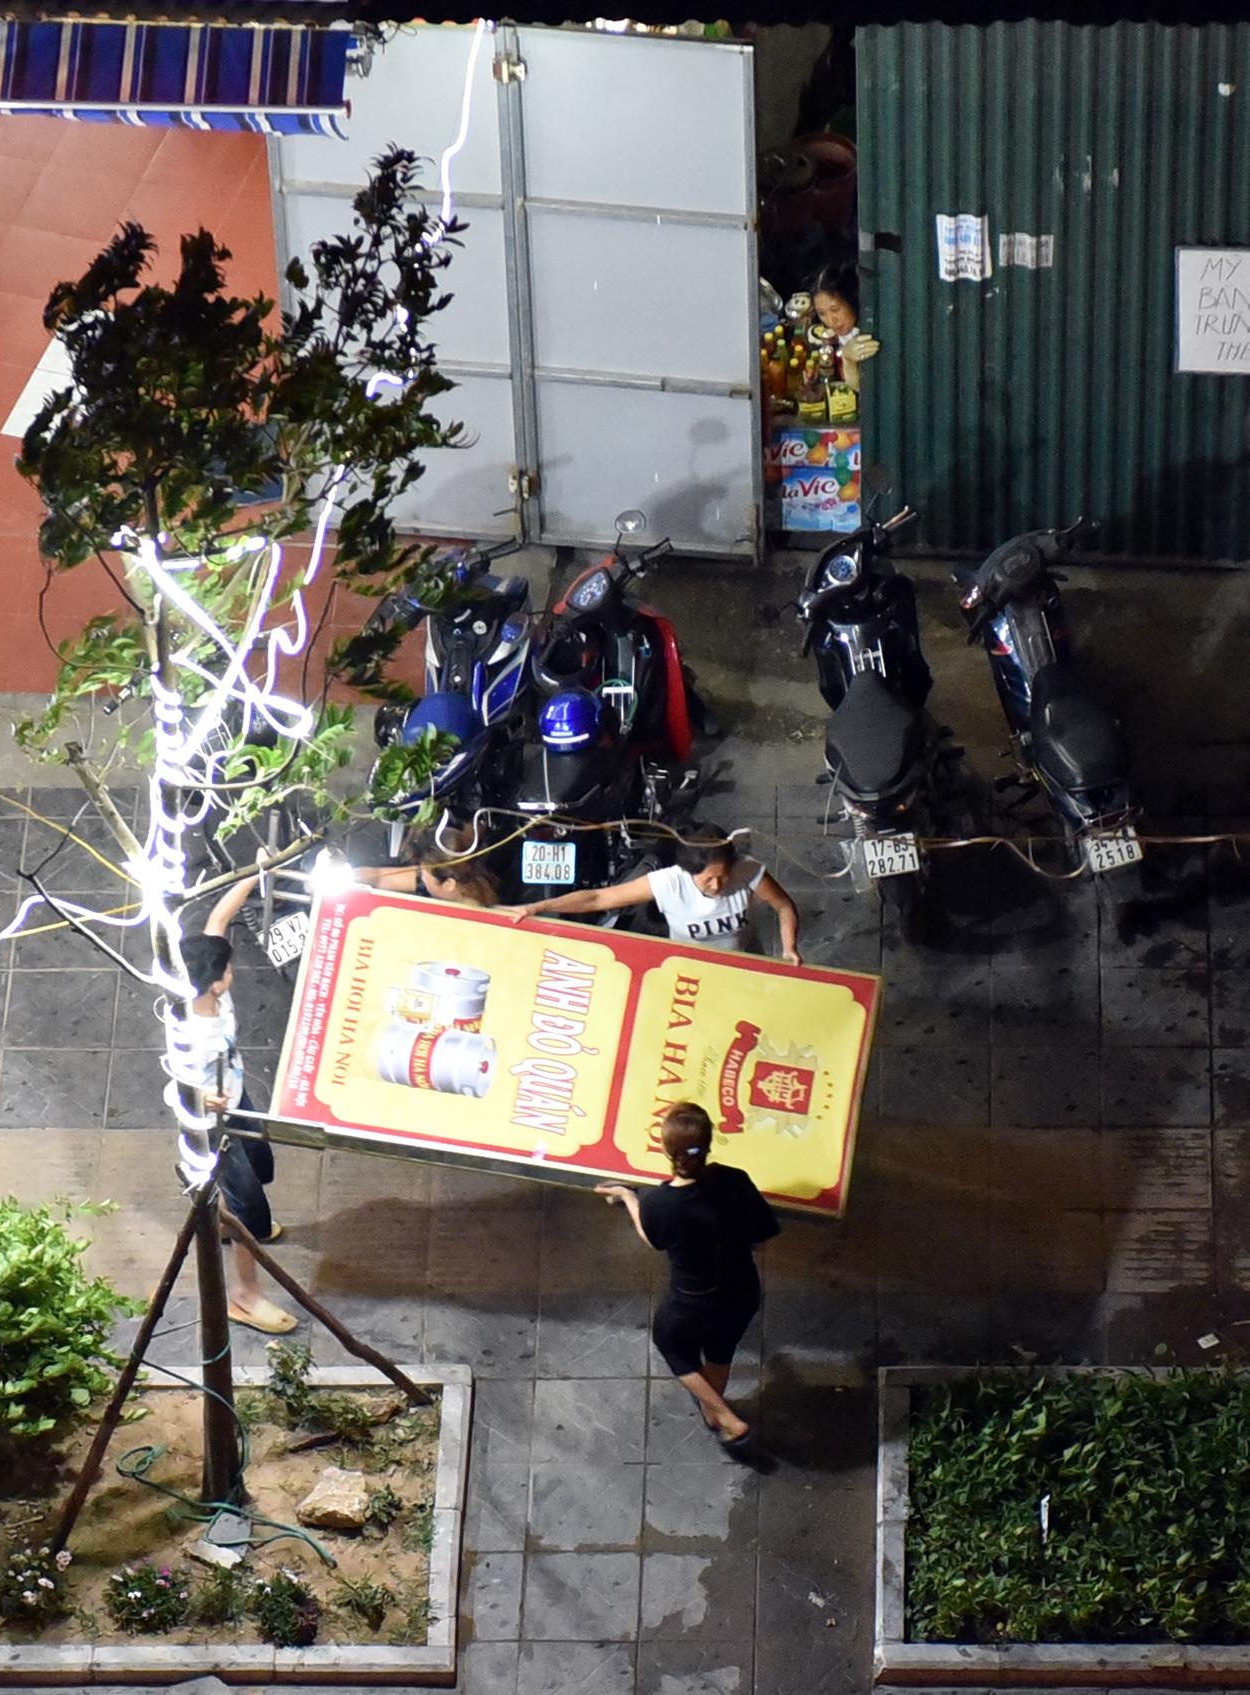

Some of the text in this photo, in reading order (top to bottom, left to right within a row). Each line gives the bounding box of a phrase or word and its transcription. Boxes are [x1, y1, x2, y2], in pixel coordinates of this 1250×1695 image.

[532, 845, 566, 862] 20-H1
[1096, 844, 1135, 869] 2518
[687, 909, 749, 939] PINK
[354, 937, 375, 972] BIA
[534, 949, 597, 1015] ANH
[668, 974, 701, 1030] BIA
[509, 1057, 587, 1135] QUÁN
[722, 1049, 744, 1107] HABECO
